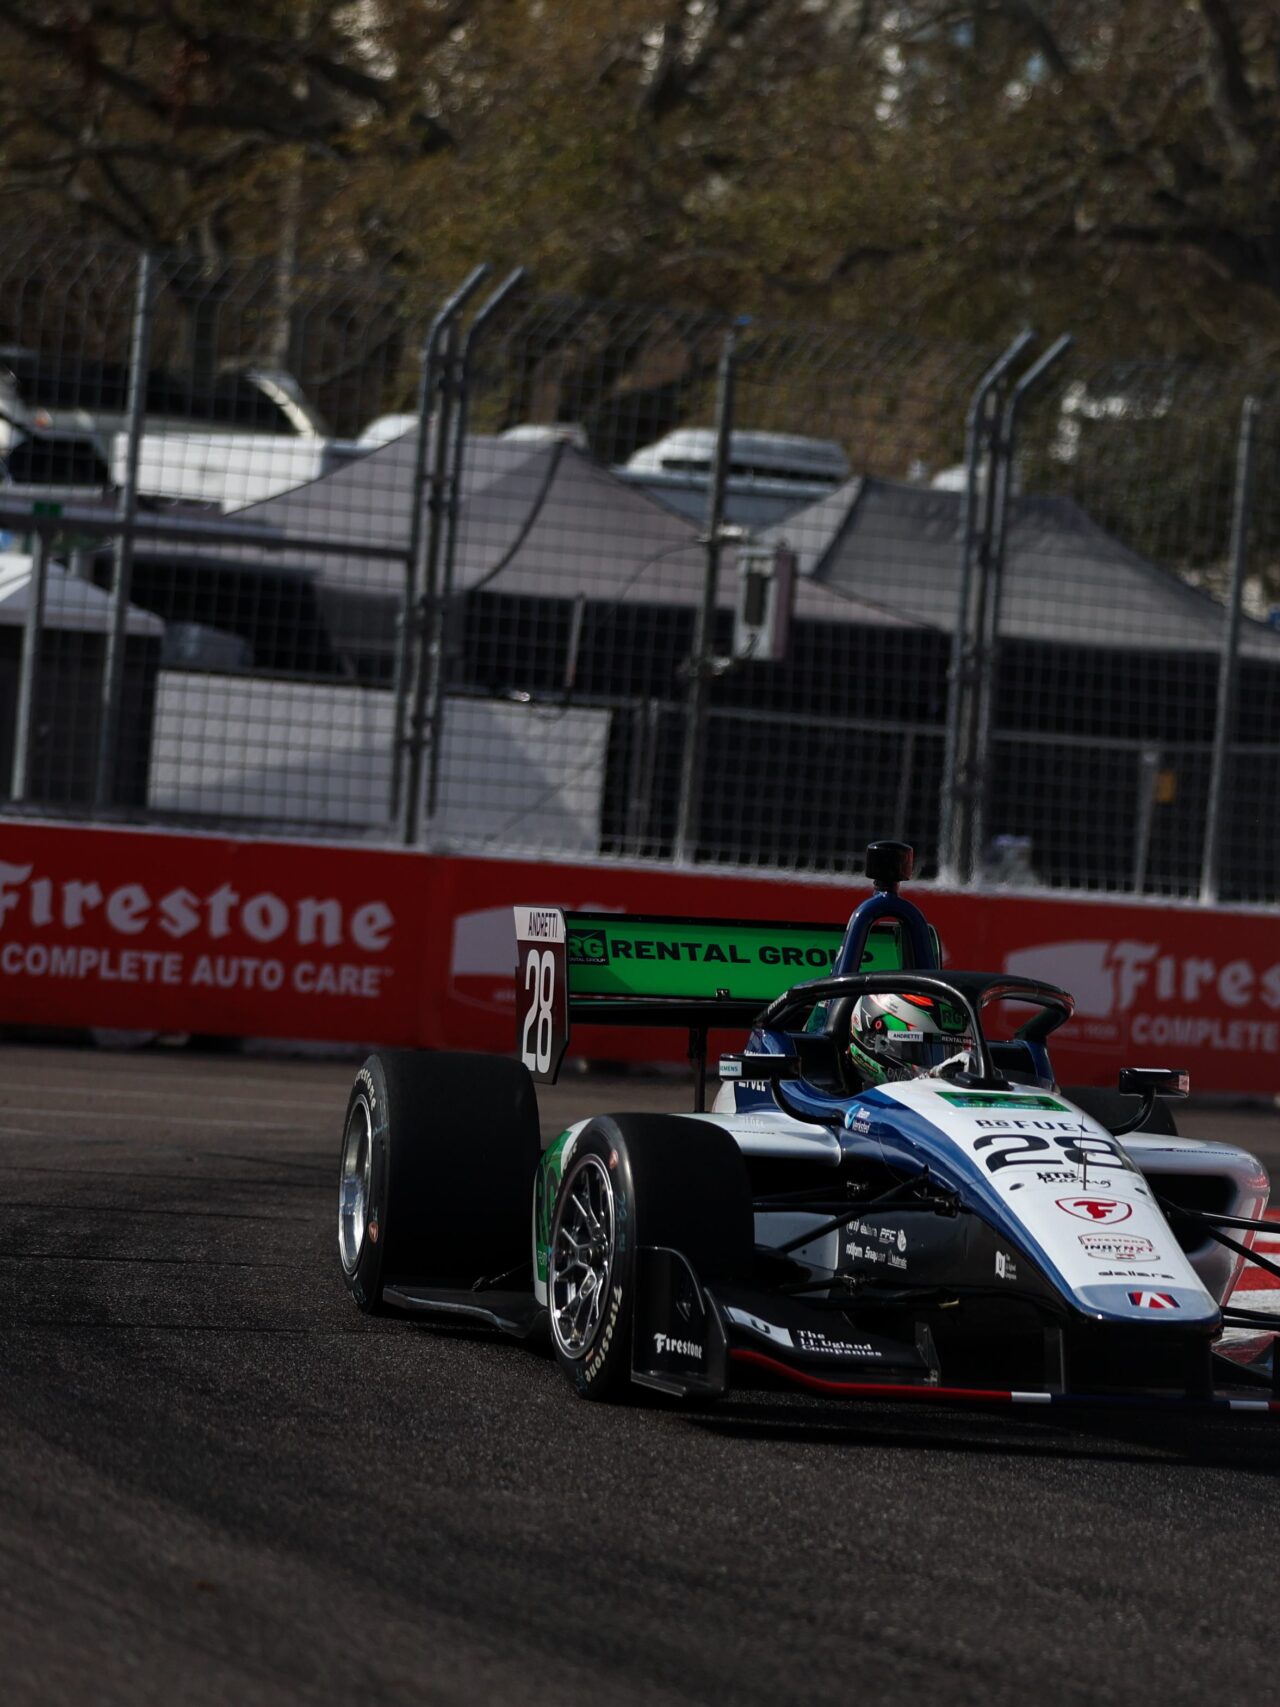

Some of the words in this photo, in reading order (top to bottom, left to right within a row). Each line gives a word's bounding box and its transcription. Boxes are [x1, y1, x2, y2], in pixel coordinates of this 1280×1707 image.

[0, 860, 395, 951] Firestone
[528, 912, 558, 938] ANDRETTI
[612, 939, 752, 964] RENTAL
[2, 943, 182, 985] COMPLETE
[190, 954, 283, 990] AUTO
[522, 949, 555, 1073] 28
[893, 1032, 920, 1040] ANDRETTI
[1132, 1013, 1278, 1056] COMPLETE
[973, 1134, 1123, 1173] 28
[1098, 1271, 1175, 1279] dallara
[585, 1286, 623, 1383] Firestone
[653, 1333, 702, 1359] Firestone
[797, 1330, 825, 1340] The
[822, 1341, 872, 1350] Ugland
[802, 1345, 882, 1357] Companies
